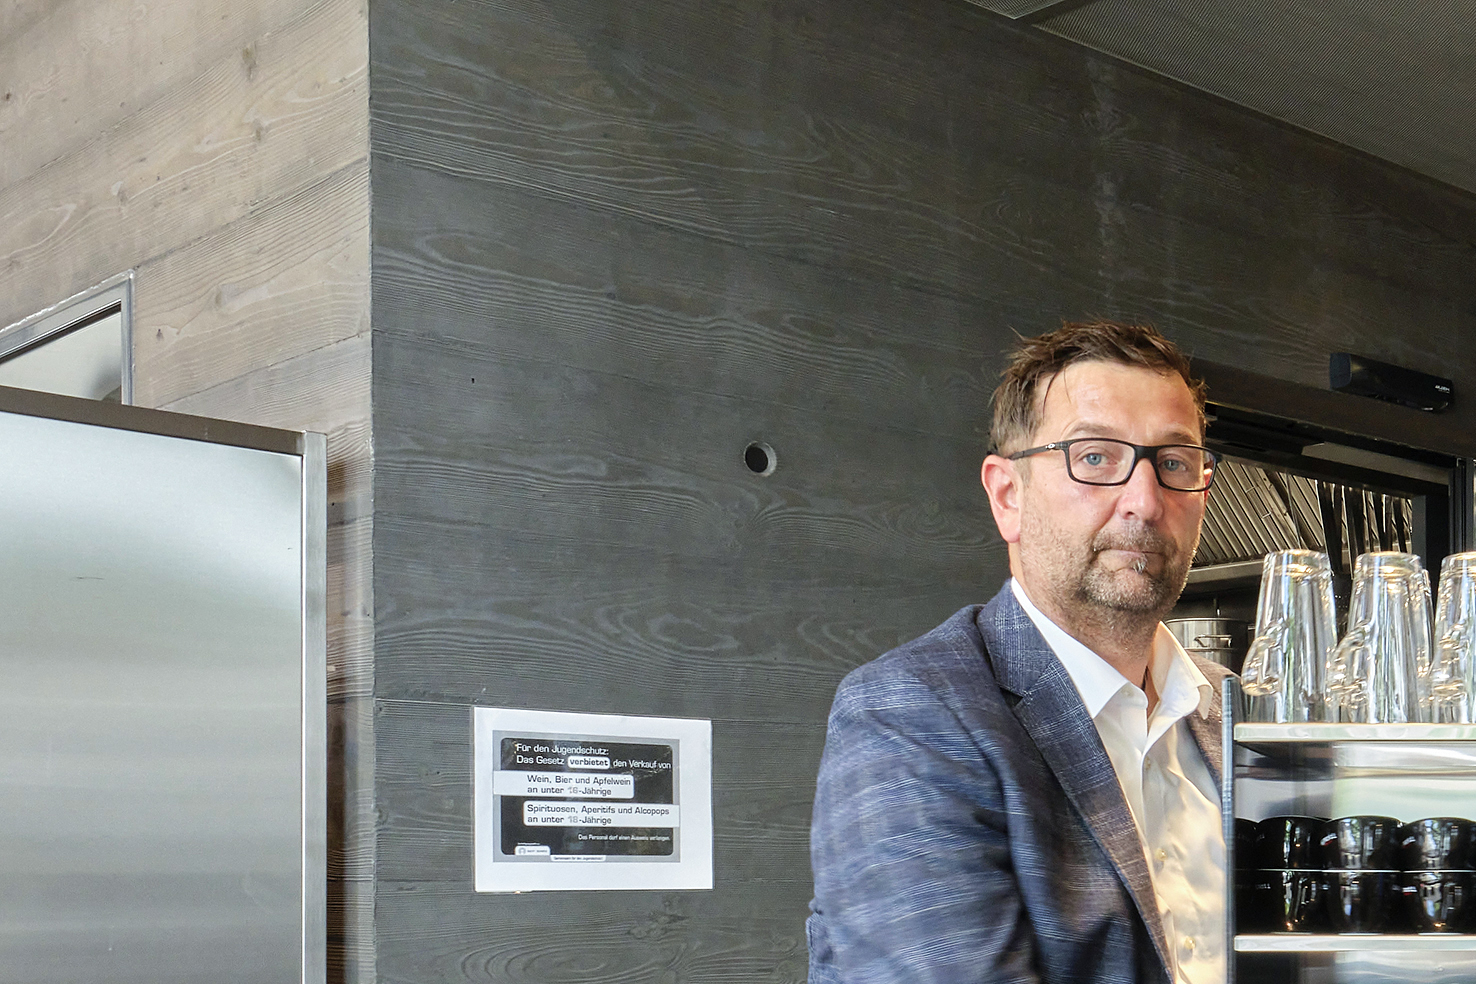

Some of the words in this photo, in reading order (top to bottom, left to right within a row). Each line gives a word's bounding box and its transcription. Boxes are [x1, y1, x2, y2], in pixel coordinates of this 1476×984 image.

[516, 743, 531, 752] Für
[534, 744, 549, 753] den
[551, 745, 609, 756] Jugendschutz:
[516, 755, 534, 764] Das
[536, 755, 565, 765] Gesetz
[570, 758, 608, 767] verbietet
[613, 759, 627, 768] den
[628, 760, 657, 769] Verkauf
[527, 775, 552, 784] Wein,
[555, 775, 573, 784] Bier
[575, 776, 590, 784] und
[593, 777, 631, 787] Apfelwein
[541, 786, 564, 794] unter
[527, 804, 578, 814] Spirituosen,
[581, 805, 616, 815] Aperitifs
[618, 806, 632, 814] und
[634, 806, 670, 816] Alcopops
[541, 816, 564, 824] unter
